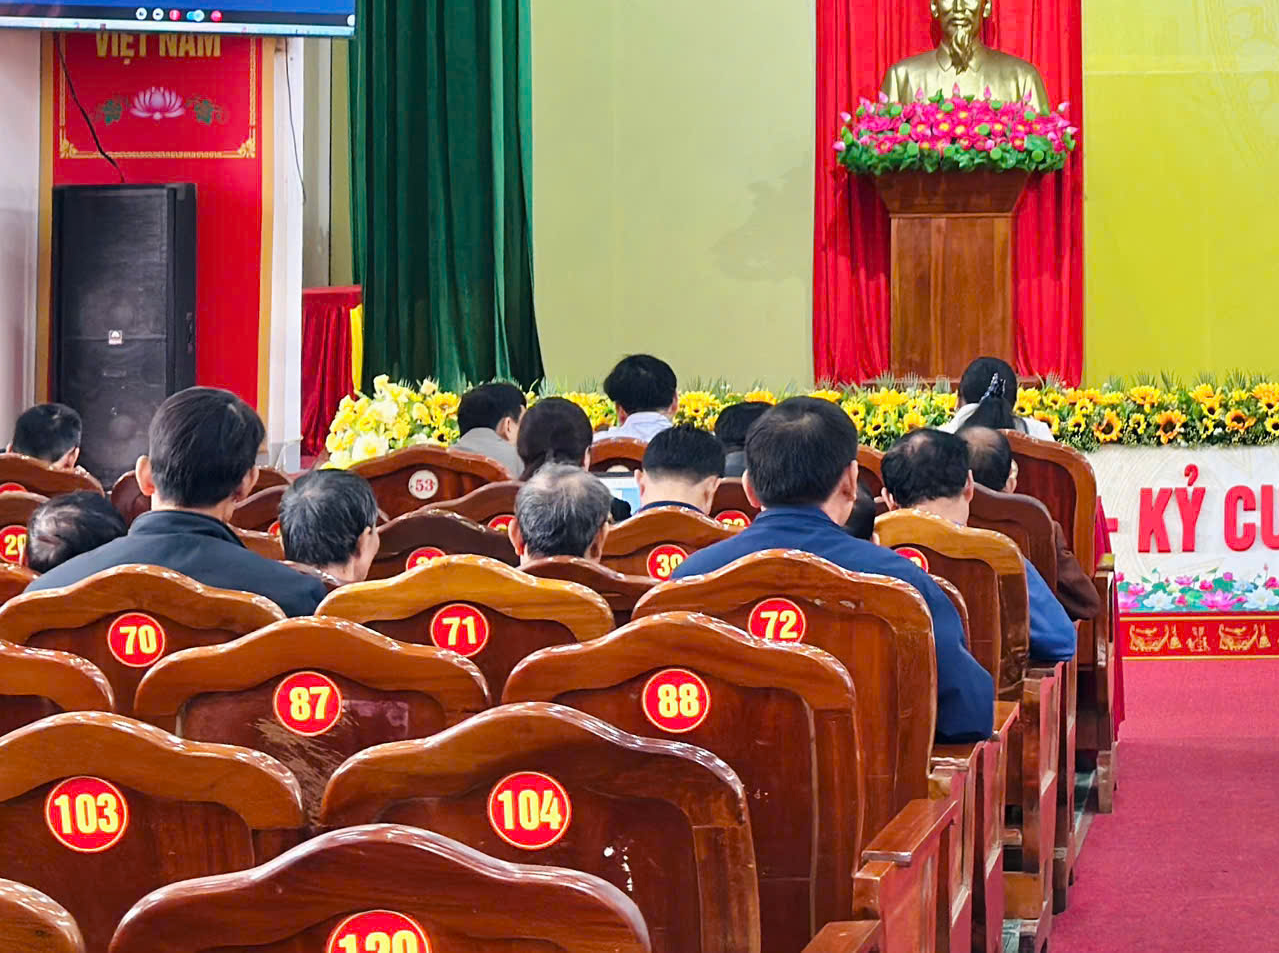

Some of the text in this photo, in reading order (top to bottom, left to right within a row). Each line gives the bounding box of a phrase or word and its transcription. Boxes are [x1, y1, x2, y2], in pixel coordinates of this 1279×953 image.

[159, 33, 221, 57] NAM
[415, 479, 434, 492] 53
[1138, 464, 1206, 553] KỶ
[119, 625, 156, 657] 70
[442, 616, 477, 647] 71
[760, 610, 798, 638] 72
[288, 685, 331, 721] 87
[657, 682, 700, 718] 88
[54, 792, 119, 835] 103
[498, 788, 562, 831] 104
